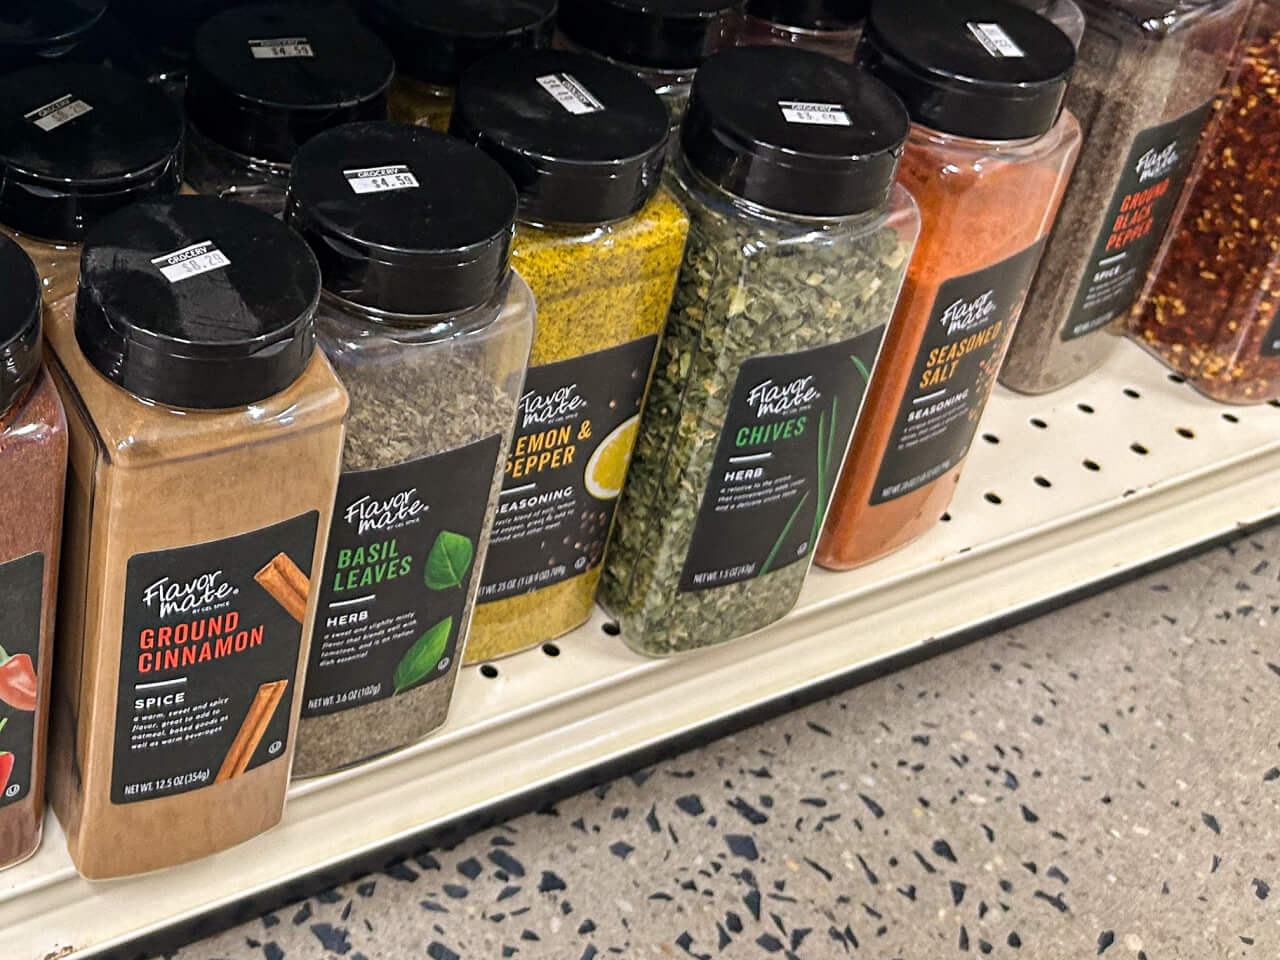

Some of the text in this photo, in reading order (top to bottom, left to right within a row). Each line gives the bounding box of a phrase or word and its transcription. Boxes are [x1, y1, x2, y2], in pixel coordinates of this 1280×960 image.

[168, 246, 207, 264] GROCERY
[927, 321, 1002, 368] SEASONED
[747, 376, 813, 405] Flavor
[920, 361, 959, 389] SALT
[908, 389, 969, 422] SEASONING
[508, 420, 591, 459] EMON &
[735, 416, 807, 447] CHIVES
[725, 467, 763, 482] HERB
[344, 488, 416, 523] Flavor
[337, 539, 399, 569] BASIL
[143, 570, 222, 606] Flavor
[333, 555, 413, 591] LEAVES
[140, 611, 239, 650] GROUND
[326, 610, 368, 627] HERB
[138, 625, 264, 674] CINNAMON
[134, 692, 186, 710] SPICE
